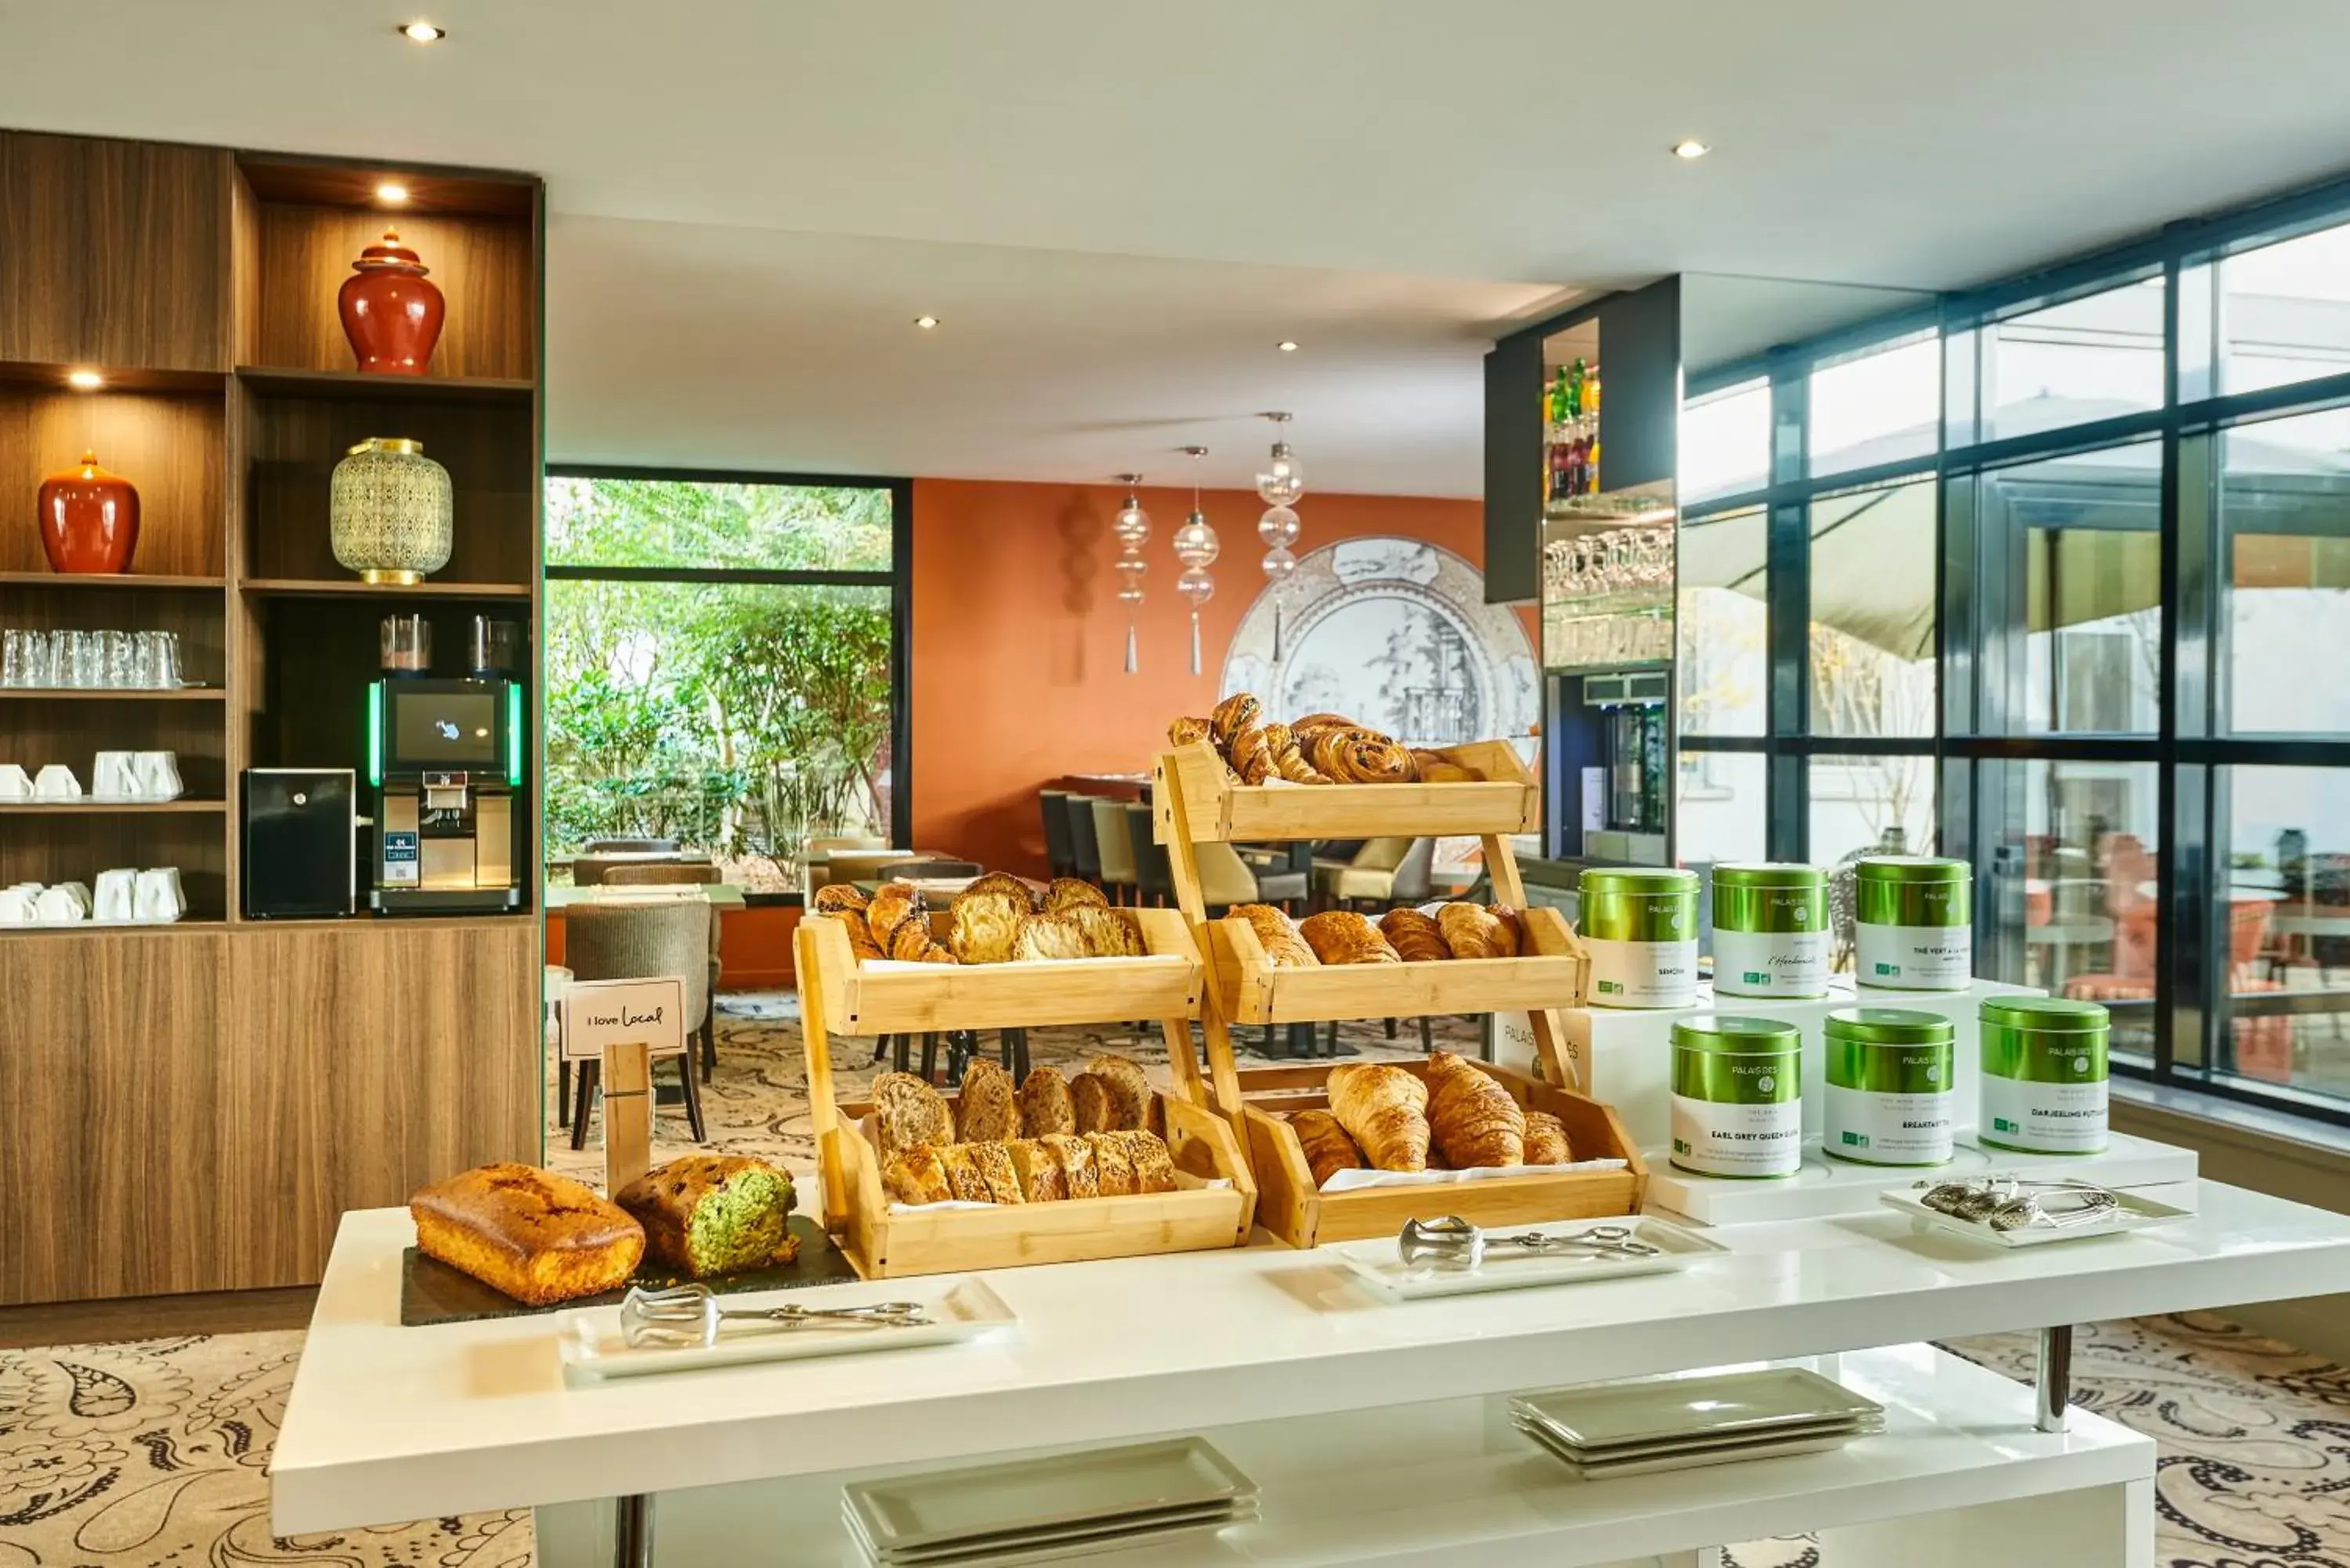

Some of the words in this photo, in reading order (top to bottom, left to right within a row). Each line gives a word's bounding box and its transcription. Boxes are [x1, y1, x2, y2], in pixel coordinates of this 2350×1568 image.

[588, 1017, 591, 1027] I
[594, 1016, 618, 1026] love
[622, 1005, 663, 1027] Local
[1504, 1025, 1535, 1046] PALAIS
[2048, 1047, 2075, 1057] PALAIS
[1903, 1056, 1929, 1064] PALAIS
[1732, 1066, 1762, 1075] PALAIS
[1762, 1066, 1778, 1075] DES
[2031, 1108, 2081, 1118] DARJEELING
[1712, 1130, 1733, 1140] EARL
